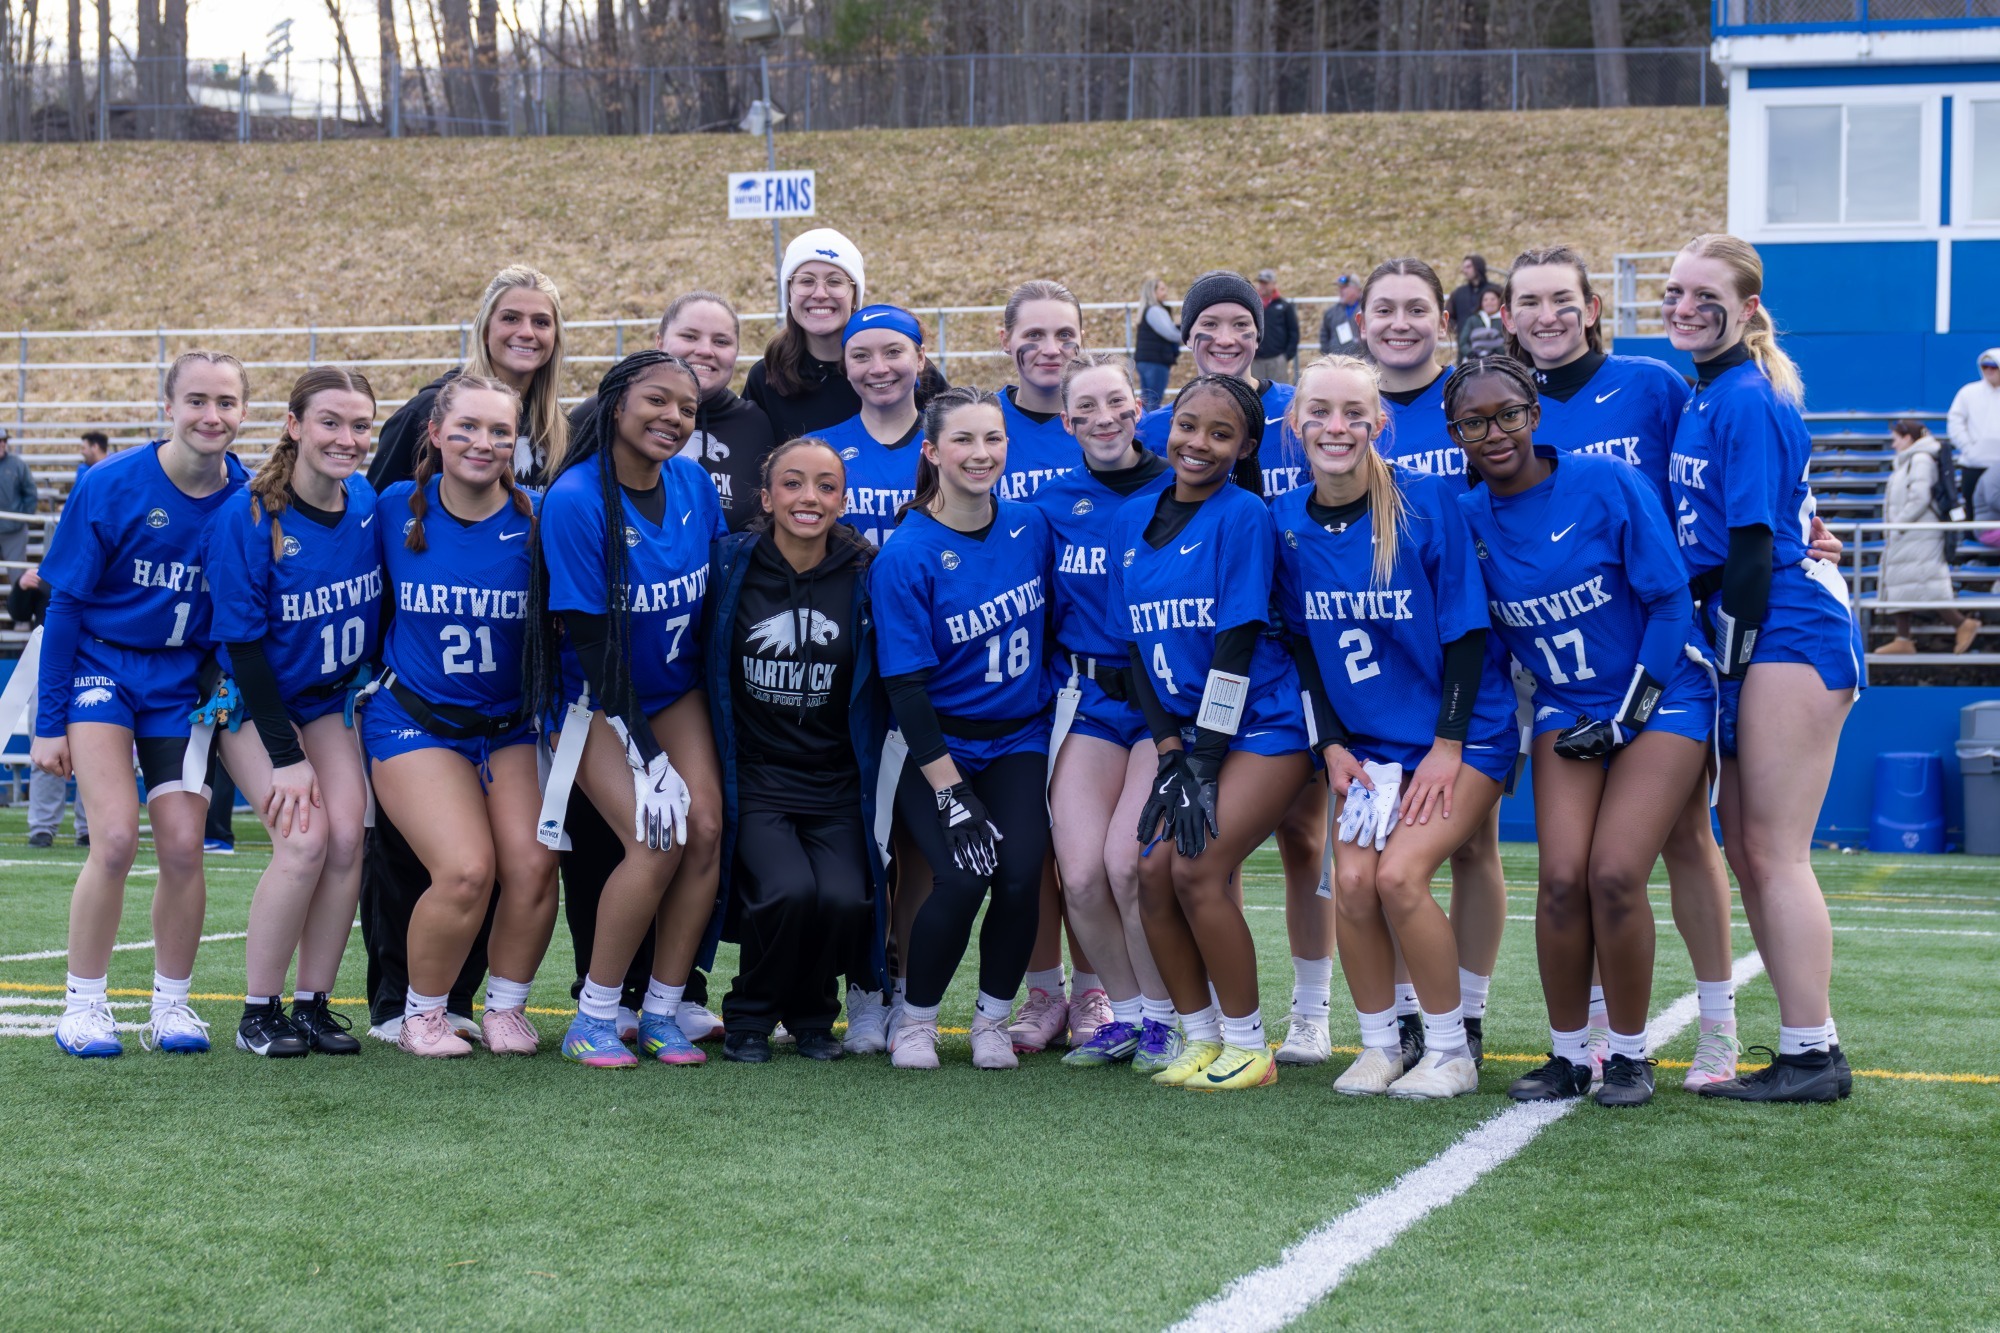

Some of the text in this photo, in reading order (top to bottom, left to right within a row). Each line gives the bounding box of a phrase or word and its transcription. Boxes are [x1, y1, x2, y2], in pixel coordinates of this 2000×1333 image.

[765, 178, 811, 212] FANS
[1058, 544, 1107, 575] HAR
[400, 581, 529, 619] HARTWICK
[1128, 597, 1216, 634] RTWICK
[1305, 589, 1413, 620] ARTWICK
[165, 601, 191, 647] 1
[320, 616, 365, 674] 10
[665, 613, 691, 664] 7
[440, 624, 497, 675] 21
[984, 626, 1030, 683] 18
[1153, 642, 1179, 695] 4
[1338, 628, 1381, 684] 2
[1534, 628, 1597, 685] 17
[74, 676, 116, 688] HARTWICK
[772, 694, 829, 708] FOOTALL
